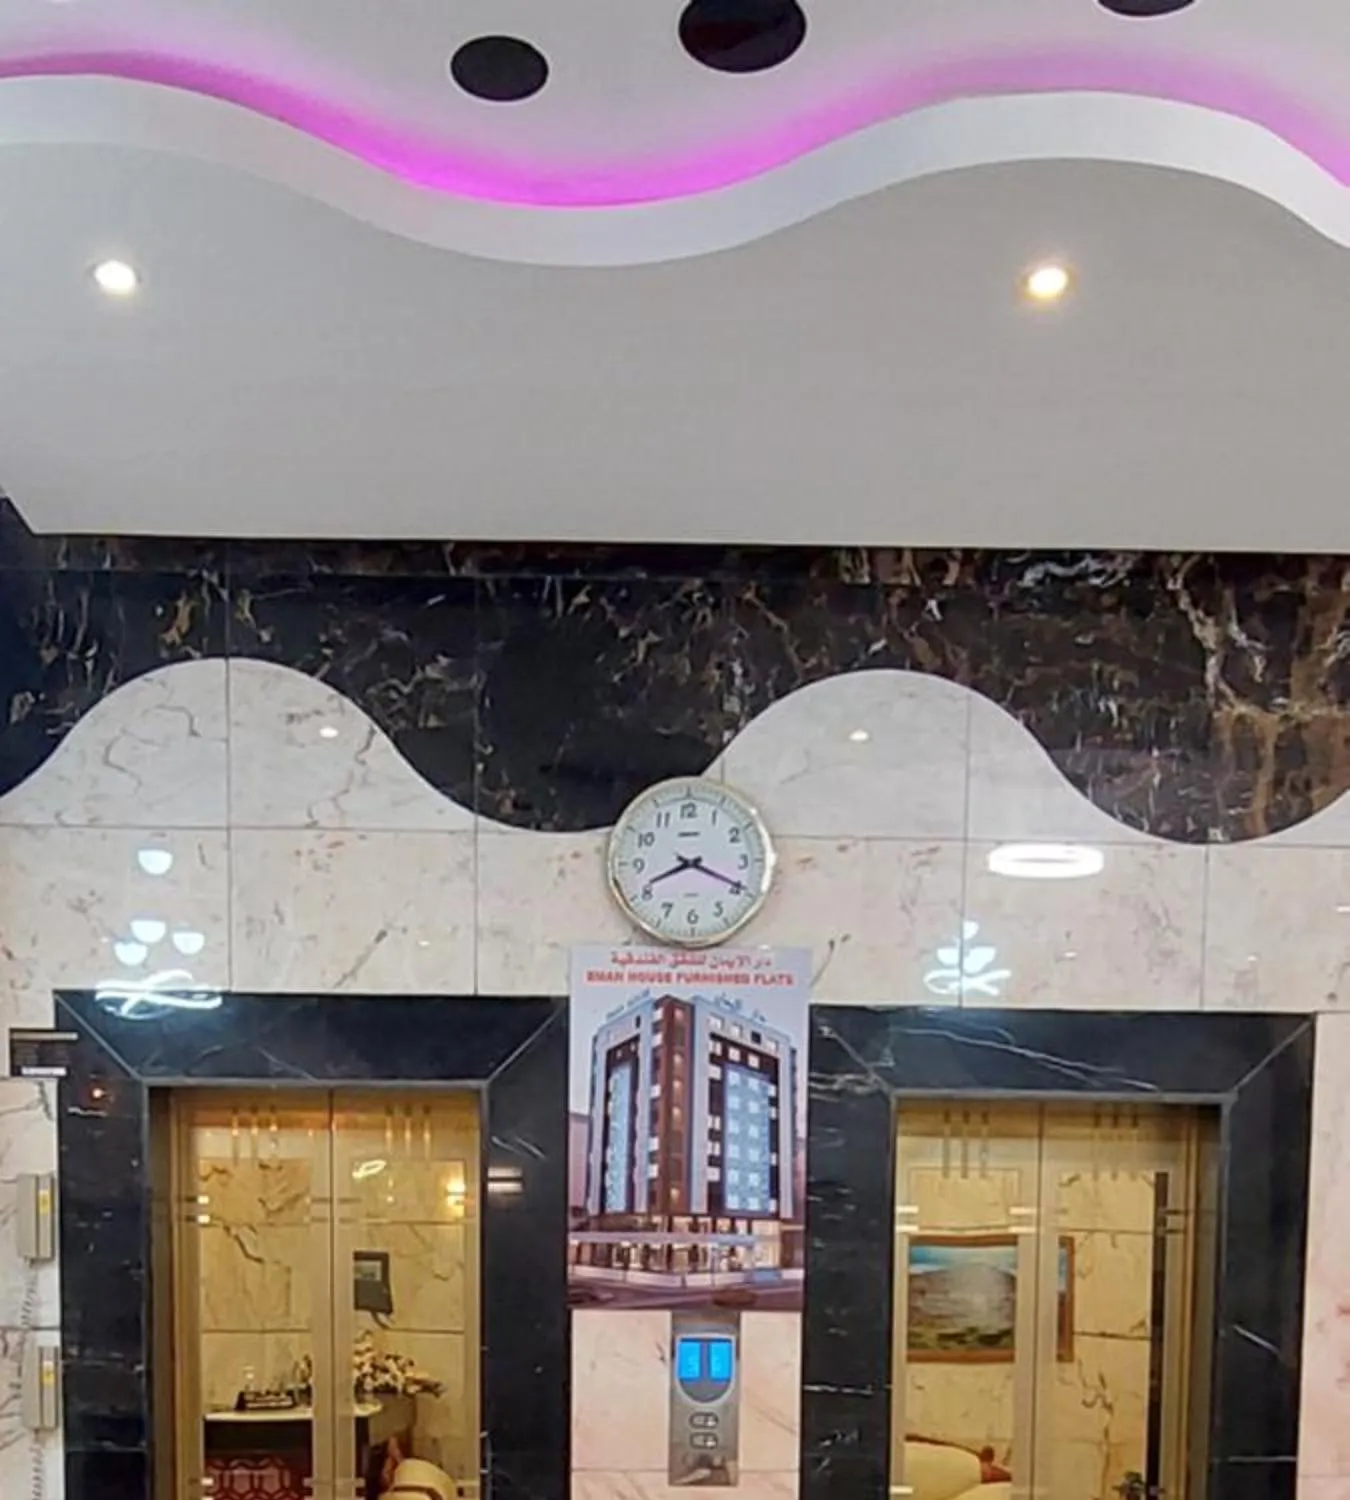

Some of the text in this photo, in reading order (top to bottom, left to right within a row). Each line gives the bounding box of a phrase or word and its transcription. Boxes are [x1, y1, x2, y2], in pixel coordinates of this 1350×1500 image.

[680, 802, 698, 819] 12
[711, 810, 717, 826] 1
[656, 812, 670, 828] 11
[638, 832, 655, 848] 10
[728, 827, 741, 843] 2
[633, 858, 645, 874] 9
[738, 855, 748, 870] 3
[642, 884, 653, 900] 8
[661, 902, 673, 918] 7
[687, 909, 699, 925] 6
[713, 901, 724, 917] 5
[627, 971, 672, 984] HOUSE
[676, 971, 750, 985] FURNISHED
[753, 973, 794, 986] FLATS
